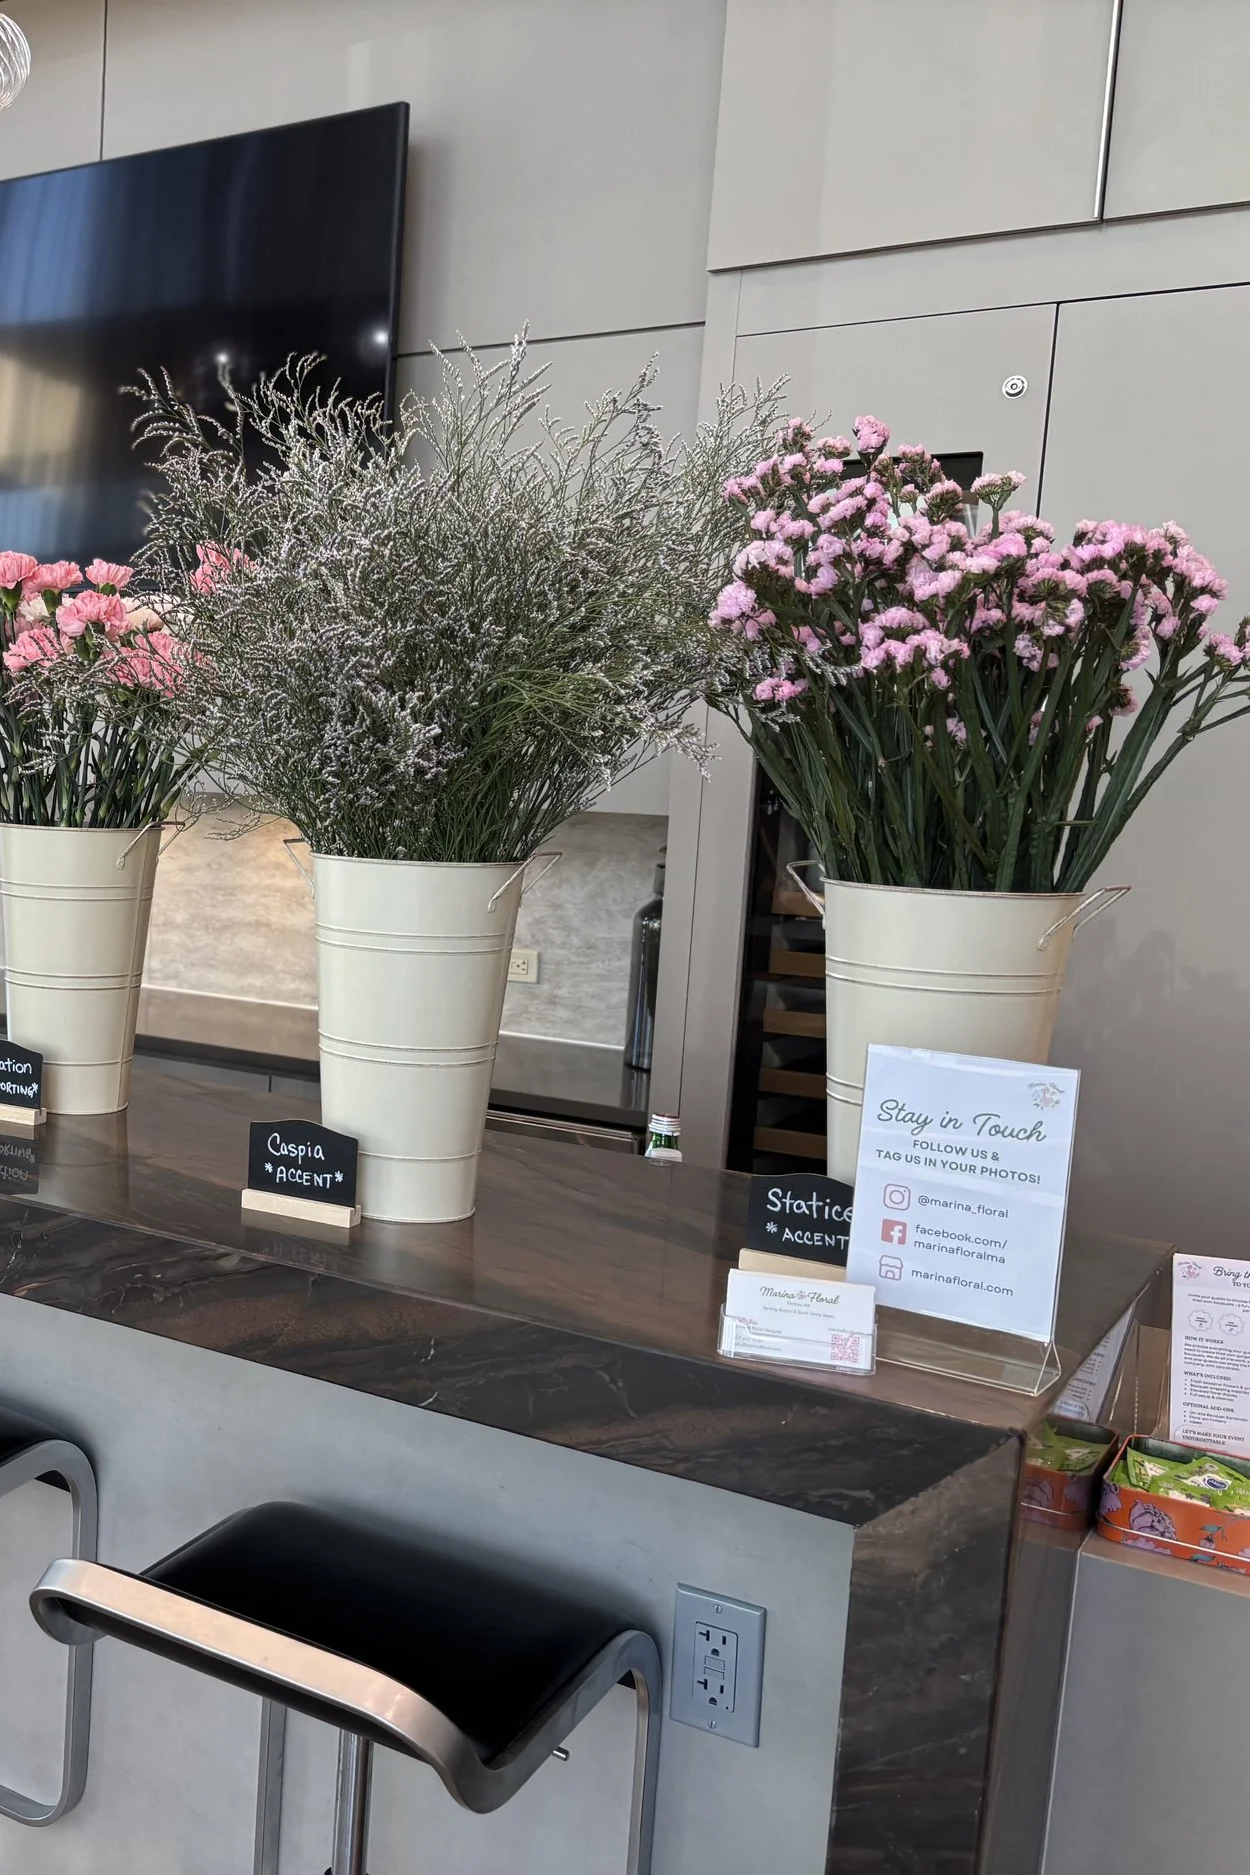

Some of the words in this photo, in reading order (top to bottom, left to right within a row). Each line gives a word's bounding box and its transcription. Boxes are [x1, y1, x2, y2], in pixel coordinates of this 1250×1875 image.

[877, 1099, 933, 1136] Stay
[939, 1111, 963, 1130] in
[972, 1113, 1047, 1142] Touch
[267, 1132, 325, 1165] Caspia
[913, 1139, 968, 1156] FOLLOW
[970, 1149, 988, 1160] US
[990, 1152, 1000, 1162] &
[876, 1149, 902, 1161] TAG
[905, 1154, 921, 1165] US
[924, 1157, 937, 1167] IN
[940, 1160, 977, 1174] YOUR
[980, 1166, 1041, 1184] PHOTOS!
[918, 1195, 1009, 1219] @marina_floral
[915, 1224, 1008, 1250] facebook.com/
[914, 1240, 1006, 1264] marinafloralma
[911, 1269, 1014, 1296] marinafloral.com
[1213, 1266, 1242, 1281] Bring
[760, 1286, 796, 1300] Marina
[807, 1291, 839, 1305] Floral
